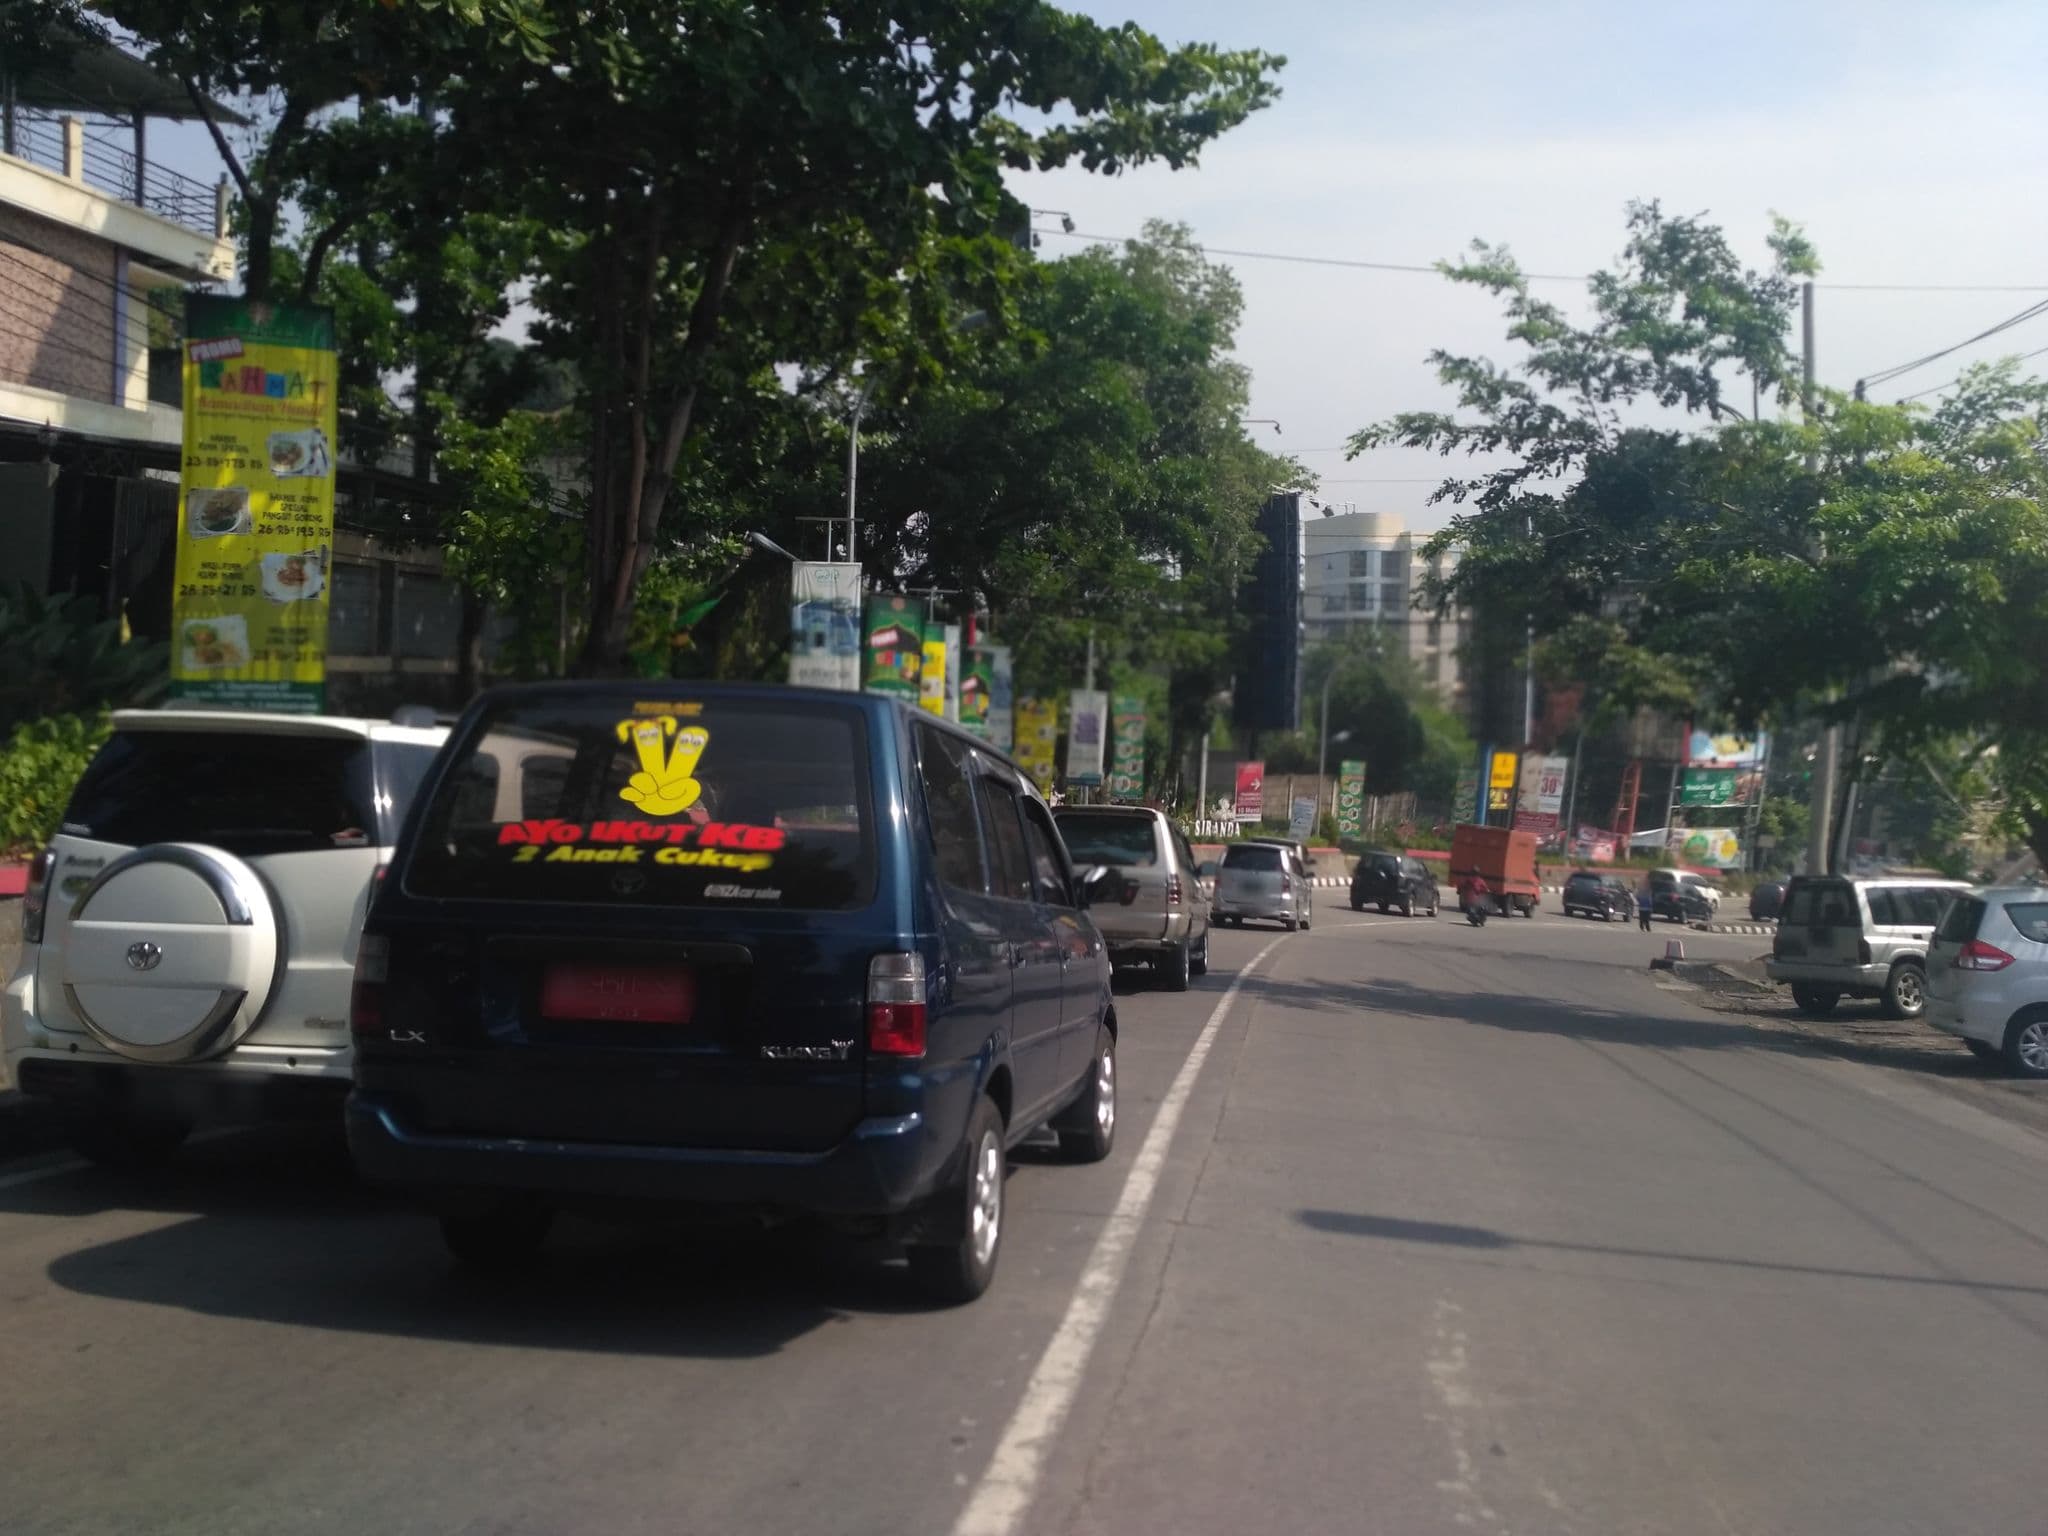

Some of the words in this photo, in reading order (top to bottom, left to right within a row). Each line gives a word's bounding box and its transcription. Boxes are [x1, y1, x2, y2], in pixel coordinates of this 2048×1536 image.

[698, 822, 785, 850] KB
[1195, 820, 1240, 837] SIRANDA
[545, 845, 644, 862] Anak
[655, 846, 773, 871] Cukup
[390, 1029, 426, 1043] LX
